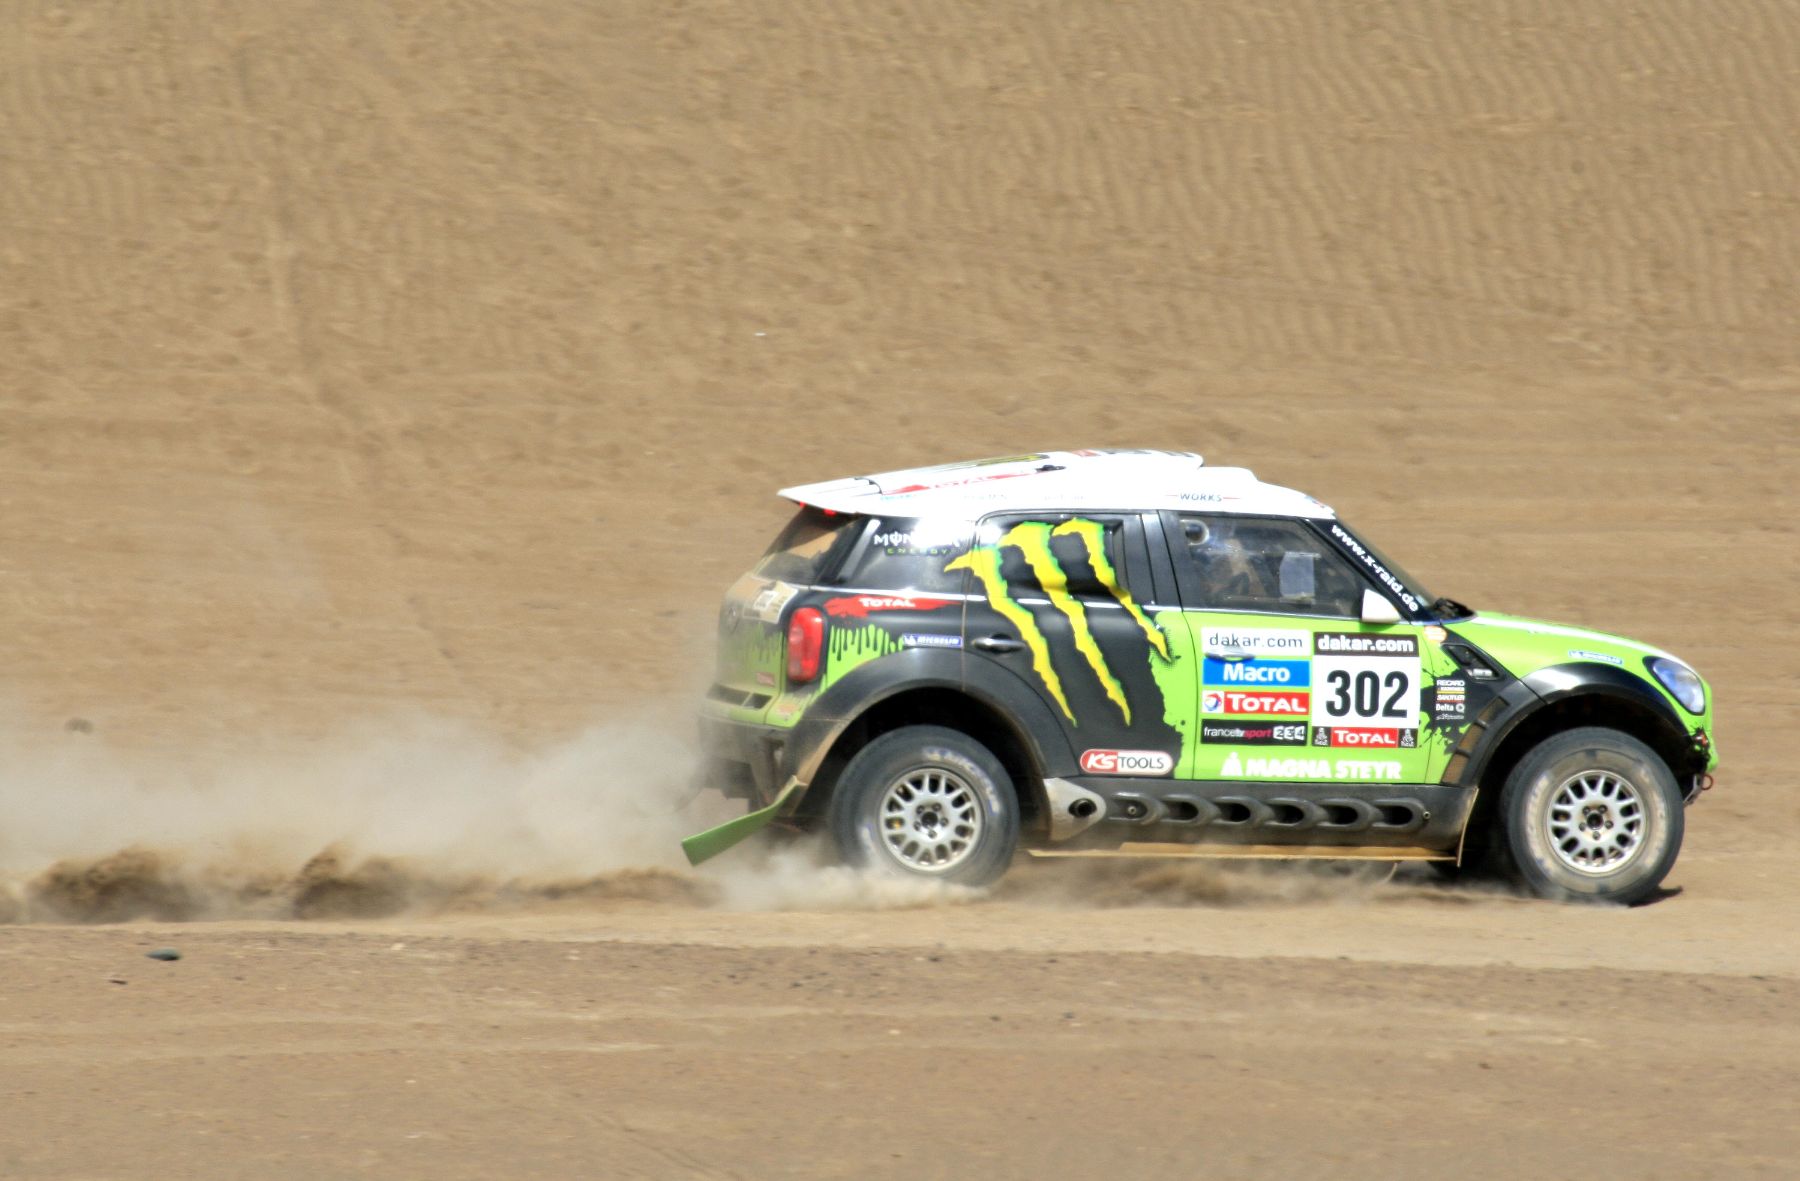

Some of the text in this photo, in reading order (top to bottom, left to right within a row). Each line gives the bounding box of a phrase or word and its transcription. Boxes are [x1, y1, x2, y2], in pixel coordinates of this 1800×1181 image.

[1180, 492, 1222, 502] WORKS
[1331, 524, 1419, 612] www.x-raid.de
[859, 597, 916, 608] TOTAL
[1209, 632, 1303, 648] dakar.com
[1317, 634, 1414, 652] dakar.com
[1223, 662, 1291, 682] Macro
[1326, 669, 1409, 718] 302
[1226, 693, 1308, 713] TOTAL
[1435, 703, 1454, 712] Delta
[1334, 730, 1396, 744] TOTAL
[1086, 753, 1164, 770] KS TOOLS
[1245, 758, 1402, 780] MAGNA STEYR
